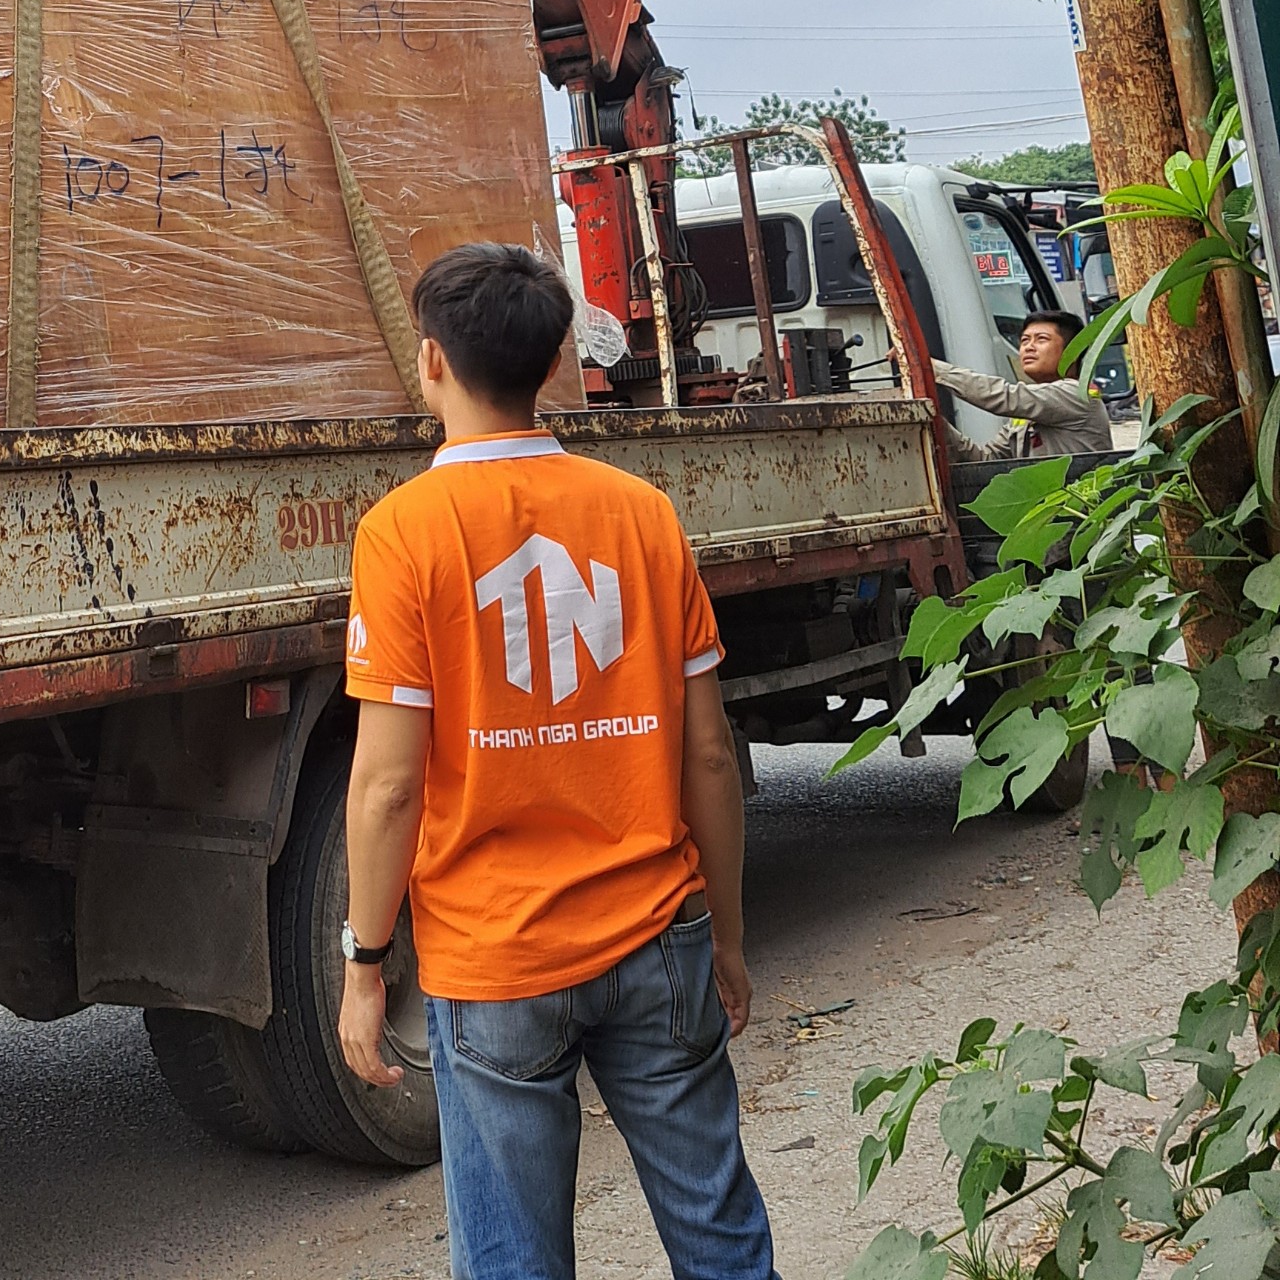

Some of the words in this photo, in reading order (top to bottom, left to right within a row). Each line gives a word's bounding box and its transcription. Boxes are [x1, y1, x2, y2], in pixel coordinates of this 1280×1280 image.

[469, 727, 535, 749] THANH
[538, 723, 577, 745] NGA
[583, 715, 659, 740] GROUP
